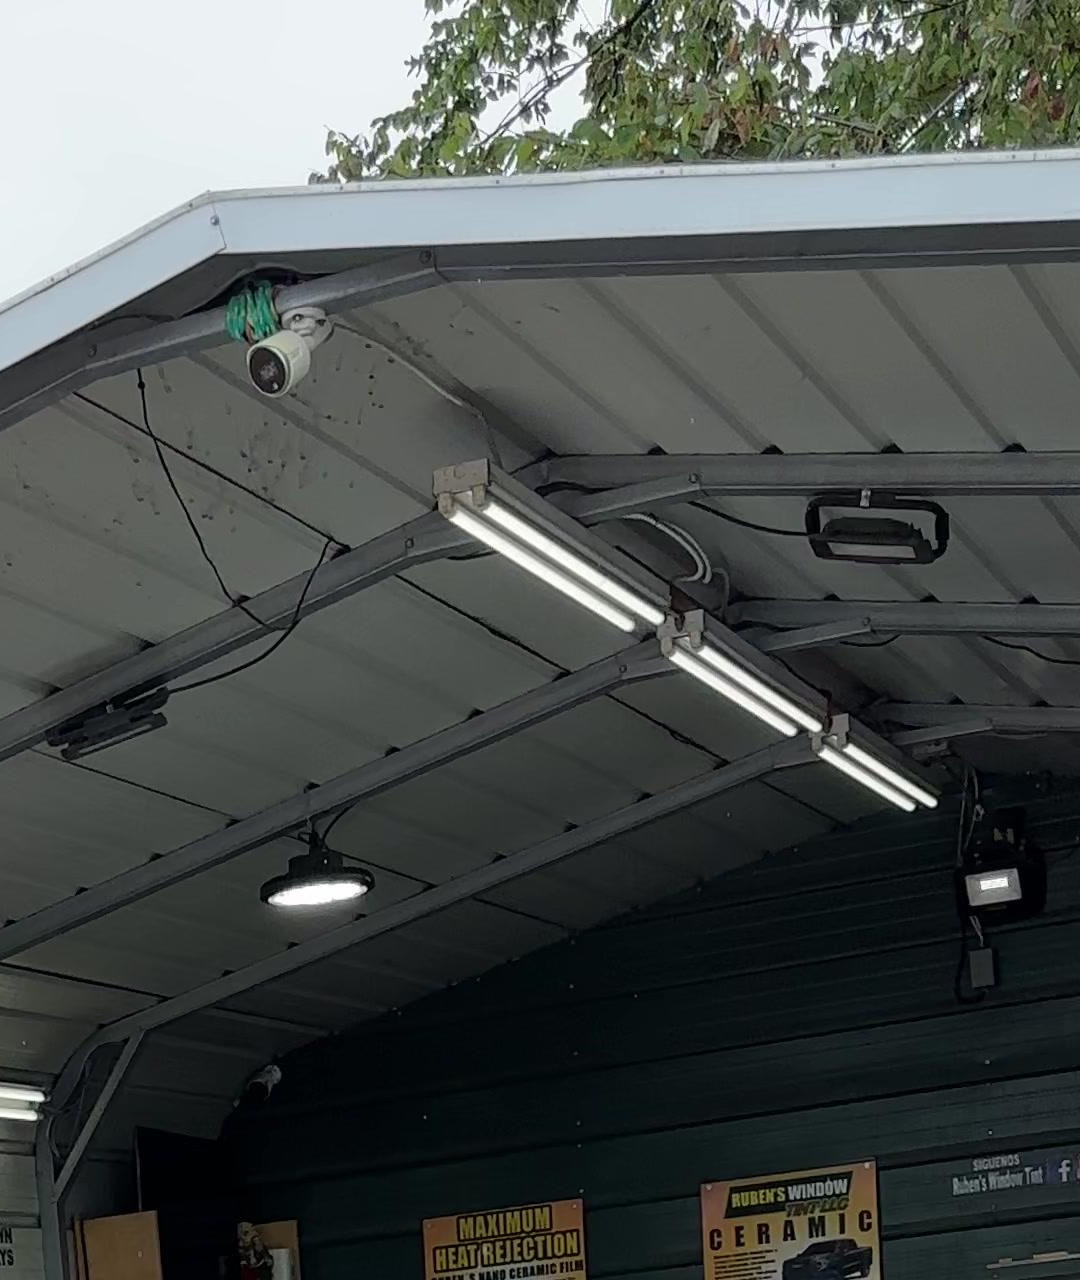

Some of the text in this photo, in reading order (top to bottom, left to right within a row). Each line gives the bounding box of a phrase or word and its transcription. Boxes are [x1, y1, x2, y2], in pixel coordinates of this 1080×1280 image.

[731, 1178, 848, 1209] RUBEN'S WINDOW
[459, 1207, 551, 1241] MAXIMUM
[709, 1210, 873, 1251] CERAMIC
[434, 1231, 579, 1272] HEAT REJECTION
[509, 1263, 557, 1279] CERAMIC
[560, 1259, 584, 1274] FILM
